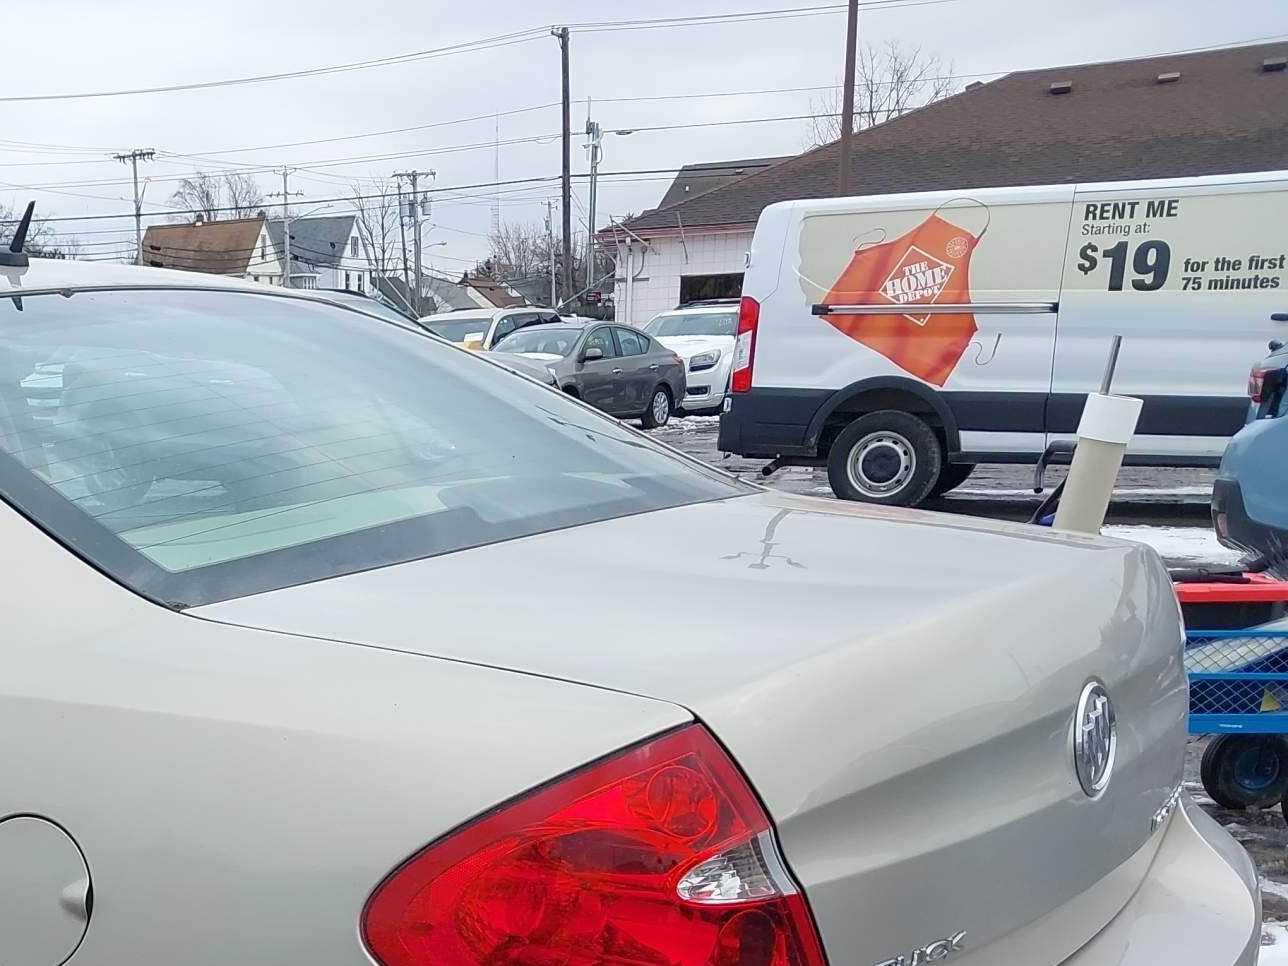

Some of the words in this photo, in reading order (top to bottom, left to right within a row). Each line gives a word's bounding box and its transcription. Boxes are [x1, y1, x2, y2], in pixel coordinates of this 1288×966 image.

[1084, 202, 1140, 221] RENT
[1145, 199, 1180, 219] ME
[1081, 223, 1131, 237] Starting
[1134, 222, 1151, 234] at:
[903, 261, 929, 276] THE
[1077, 239, 1171, 292] $19
[1183, 258, 1209, 273] for
[1214, 256, 1242, 272] the
[1247, 254, 1286, 270] first
[886, 265, 948, 297] HOME
[1181, 277, 1202, 291] 75
[1207, 275, 1280, 291] minutes
[899, 284, 941, 304] DEPOT
